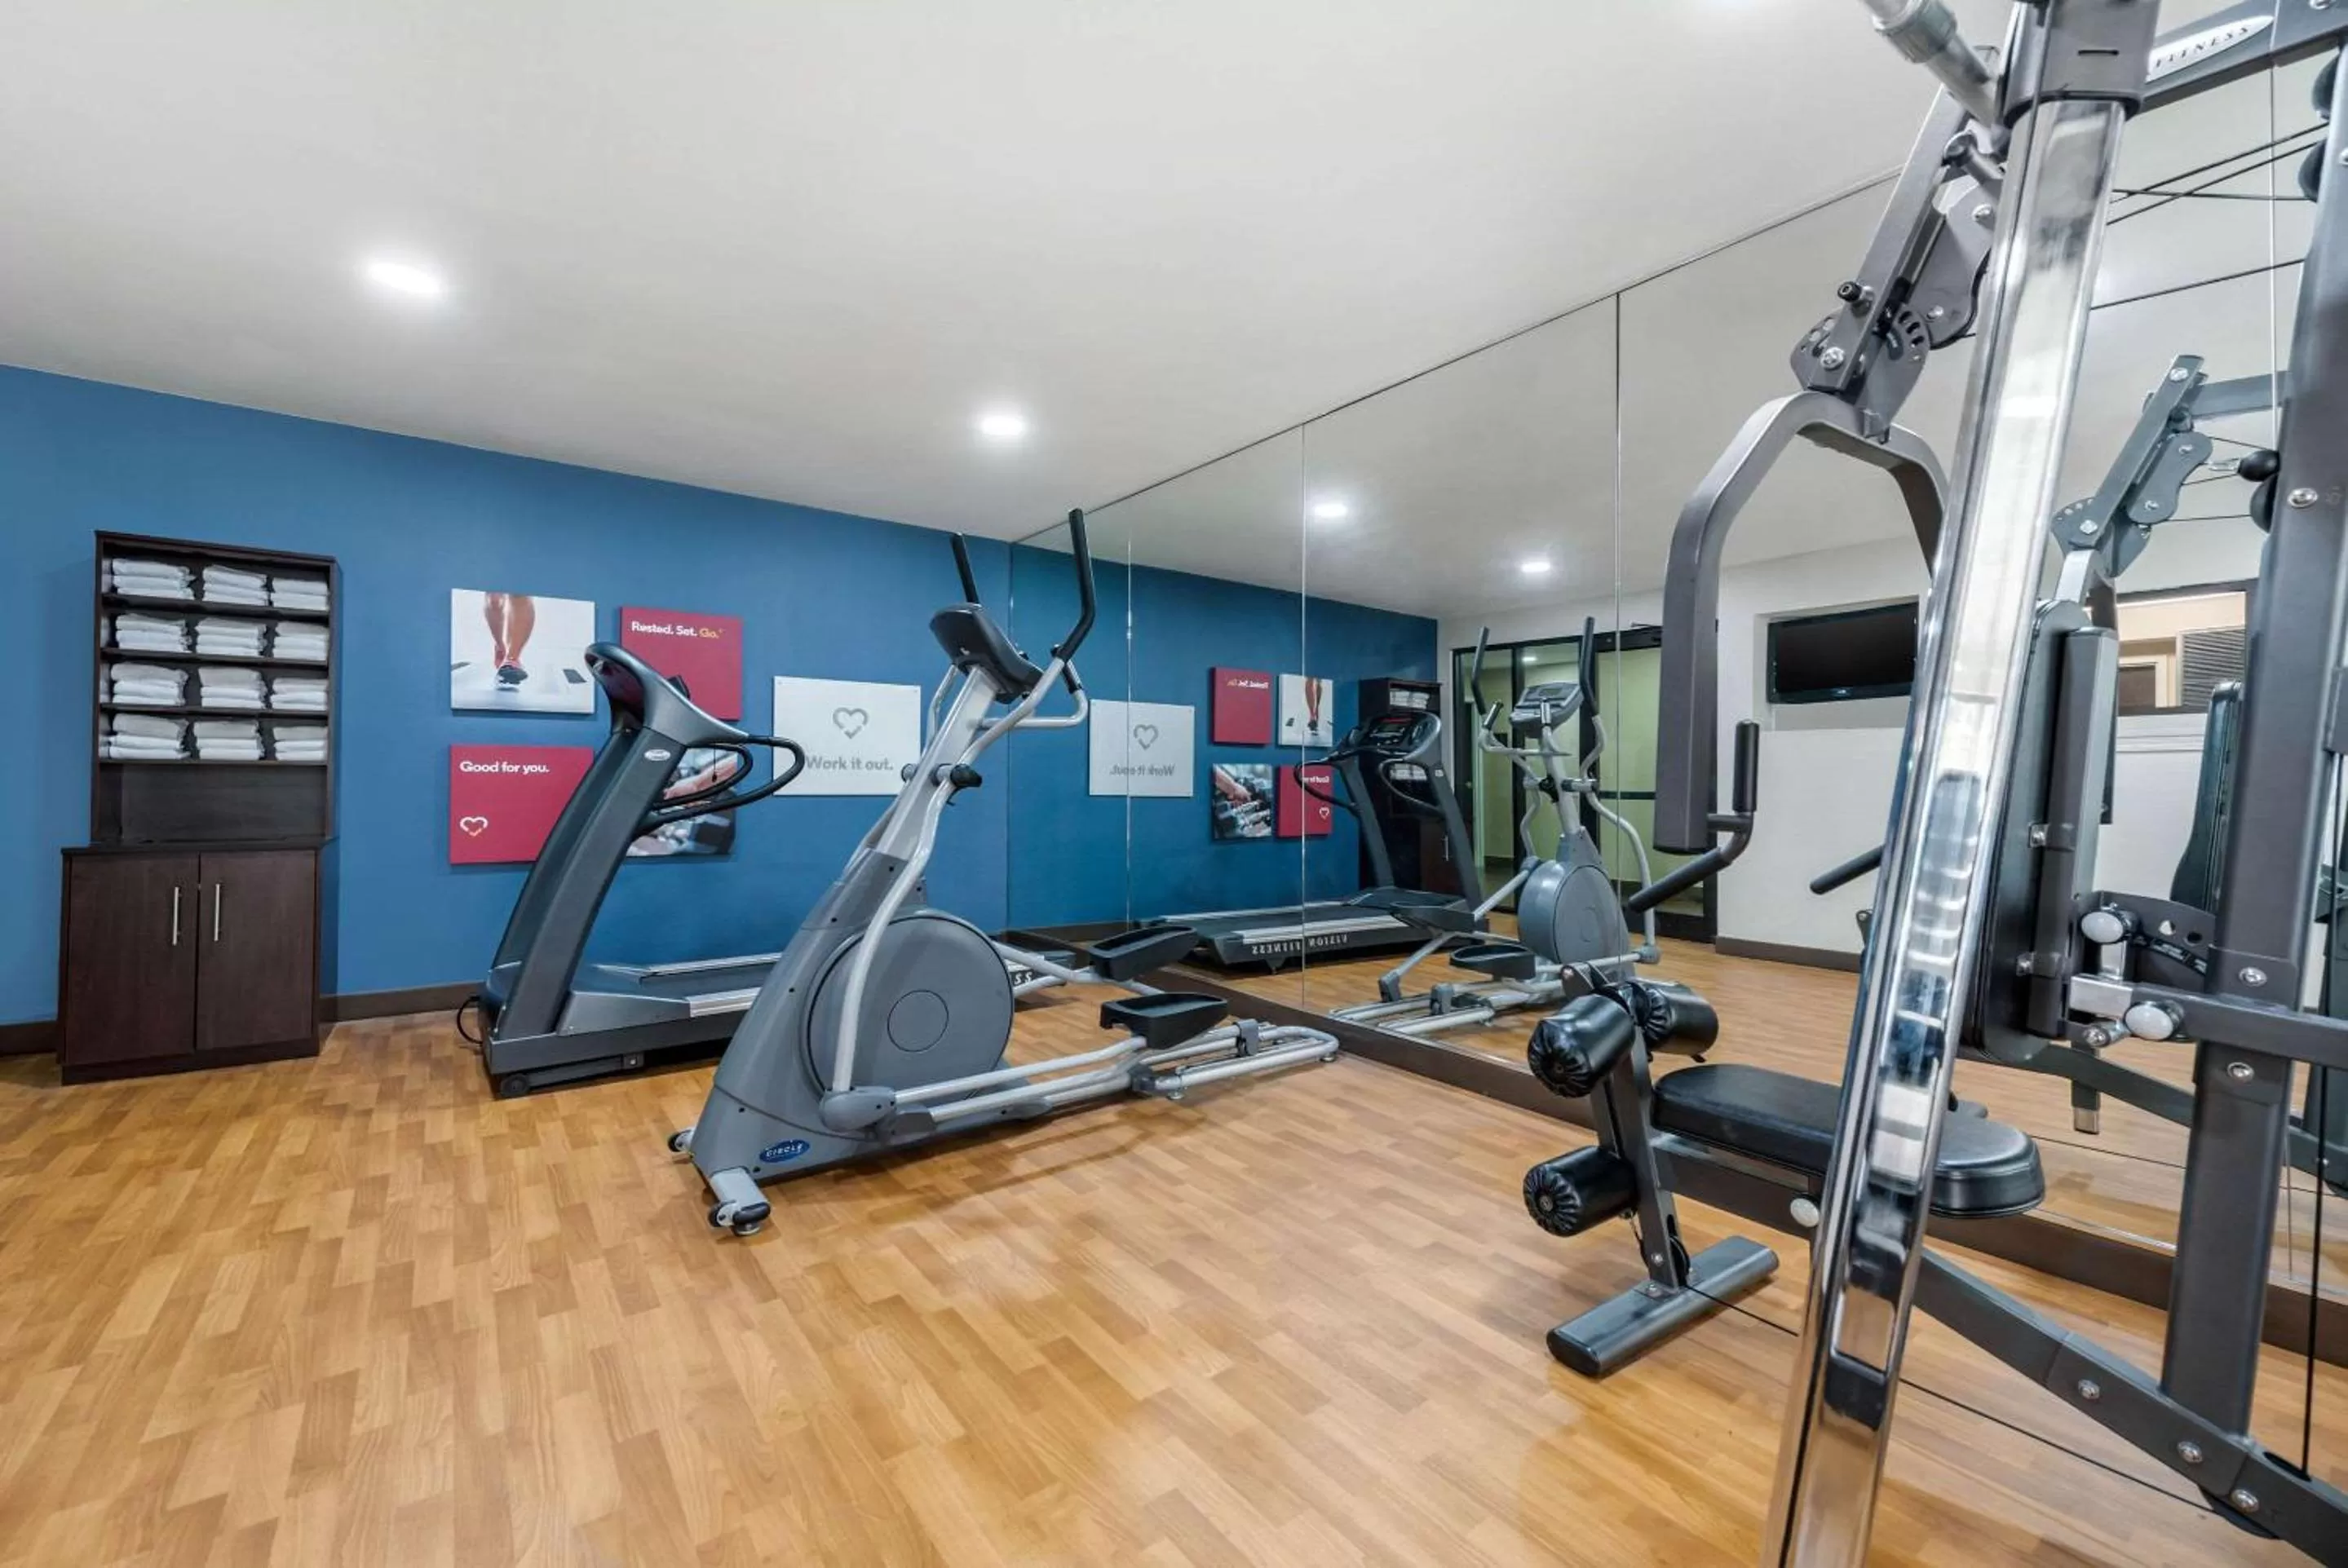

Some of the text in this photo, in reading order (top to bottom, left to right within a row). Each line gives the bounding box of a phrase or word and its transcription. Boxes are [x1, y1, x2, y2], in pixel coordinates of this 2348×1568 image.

[2156, 27, 2249, 68] FITNESS
[675, 625, 697, 637] Set.
[459, 761, 550, 775] Good for you.
[805, 755, 894, 771] Work it out.
